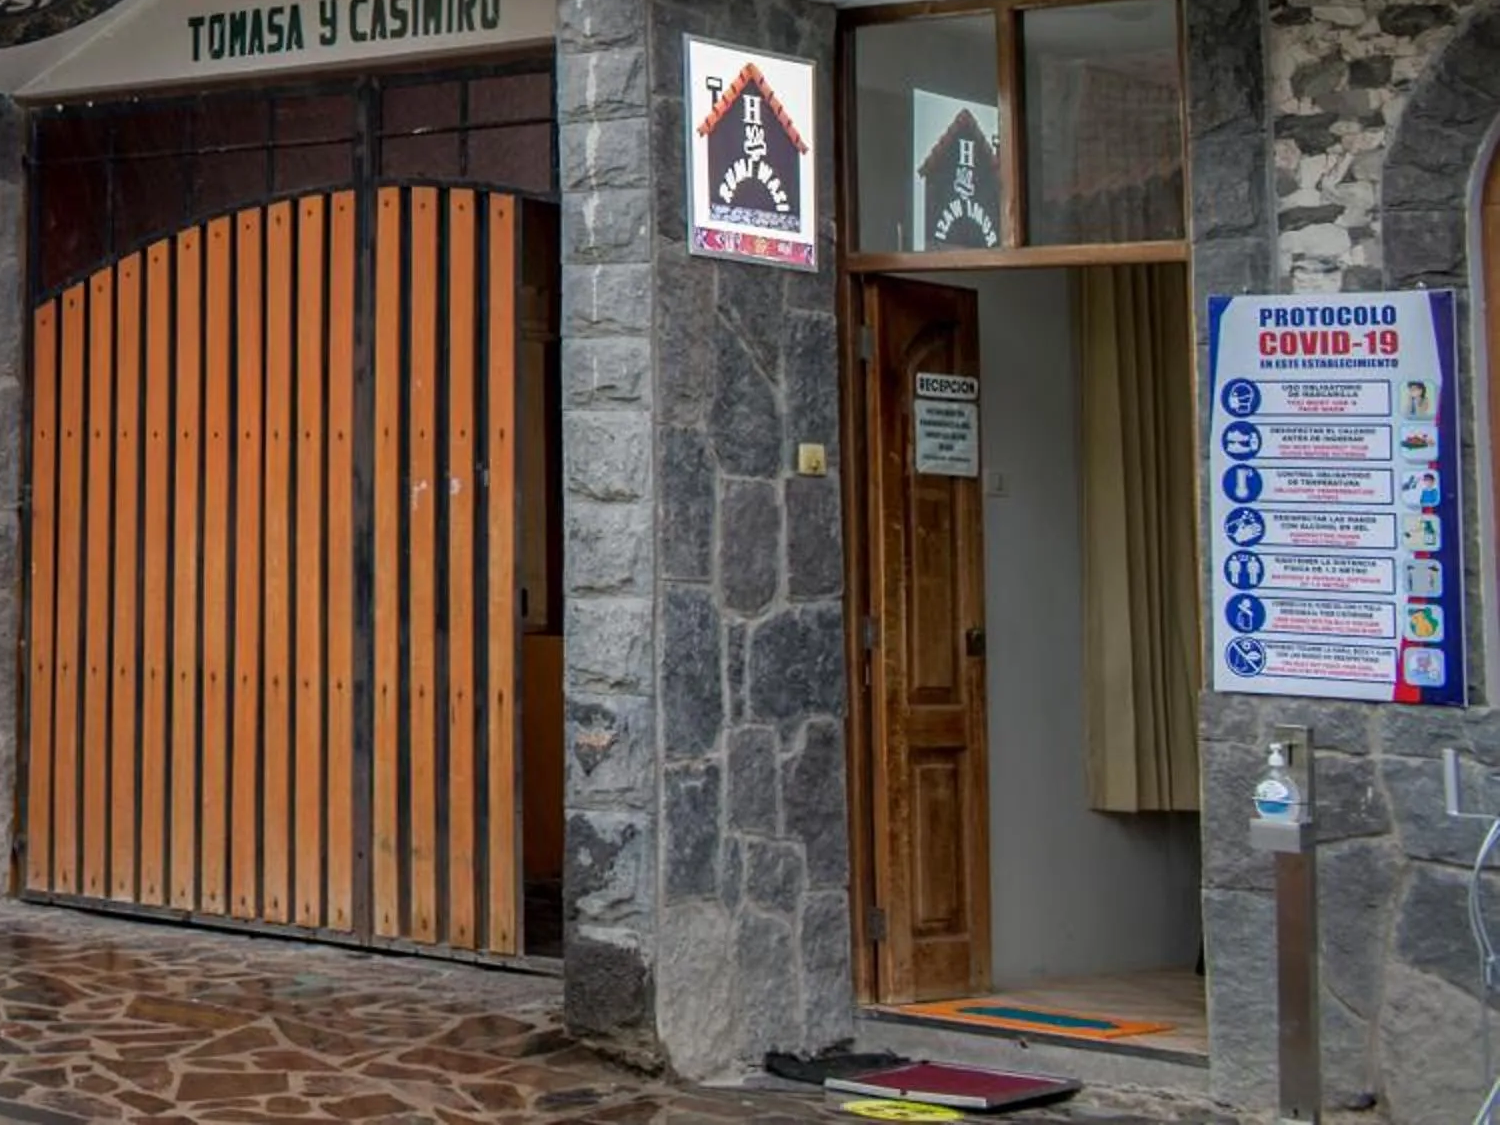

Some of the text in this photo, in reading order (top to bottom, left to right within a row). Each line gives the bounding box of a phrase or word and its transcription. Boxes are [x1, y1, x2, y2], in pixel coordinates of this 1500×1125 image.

[188, 3, 305, 62] TOMASA
[719, 158, 790, 212] RUMI WASI
[1259, 305, 1397, 327] PROTOCOLO
[1259, 330, 1399, 356] COVID-19
[1260, 358, 1399, 369] EN ESTE ESTABLECIMIENTO
[920, 377, 975, 393] RECEPCION
